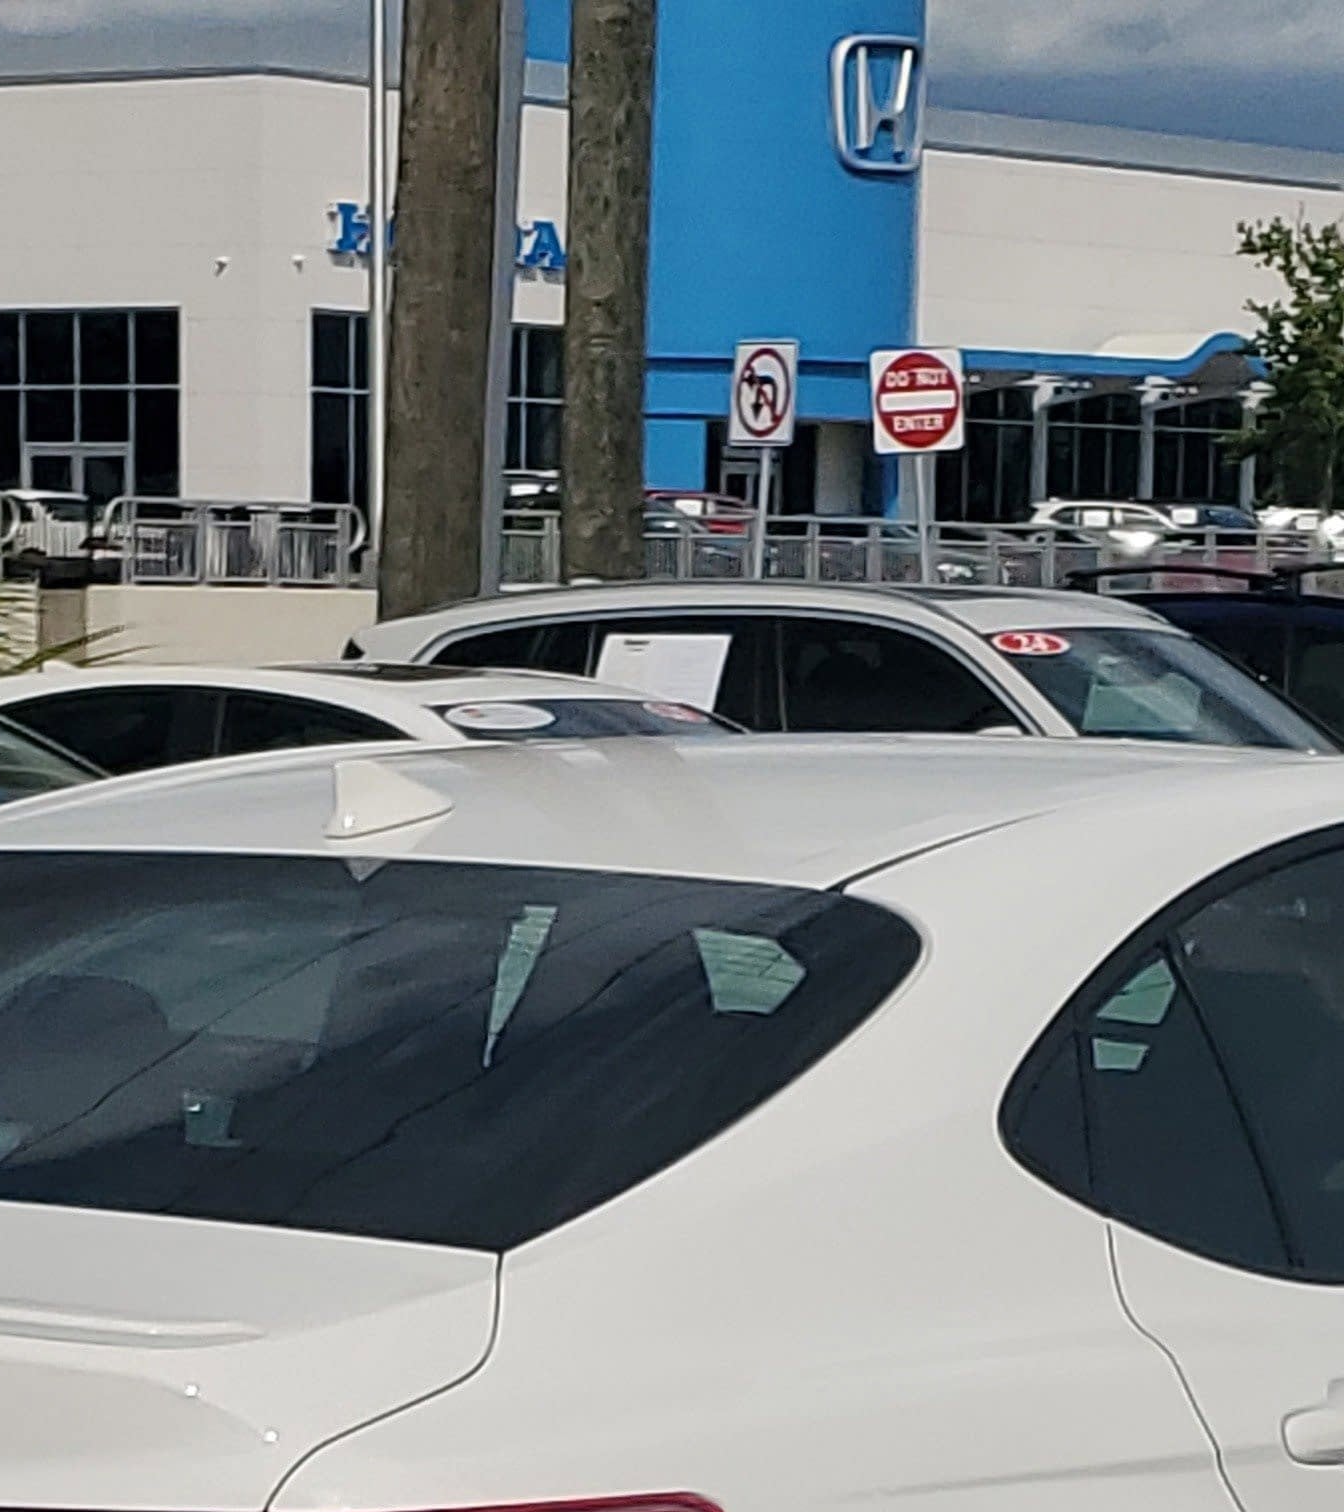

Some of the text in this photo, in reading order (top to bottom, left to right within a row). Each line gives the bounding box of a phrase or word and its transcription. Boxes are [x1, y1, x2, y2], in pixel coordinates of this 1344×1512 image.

[885, 367, 949, 388] DO NOT
[892, 413, 945, 433] ENTER
